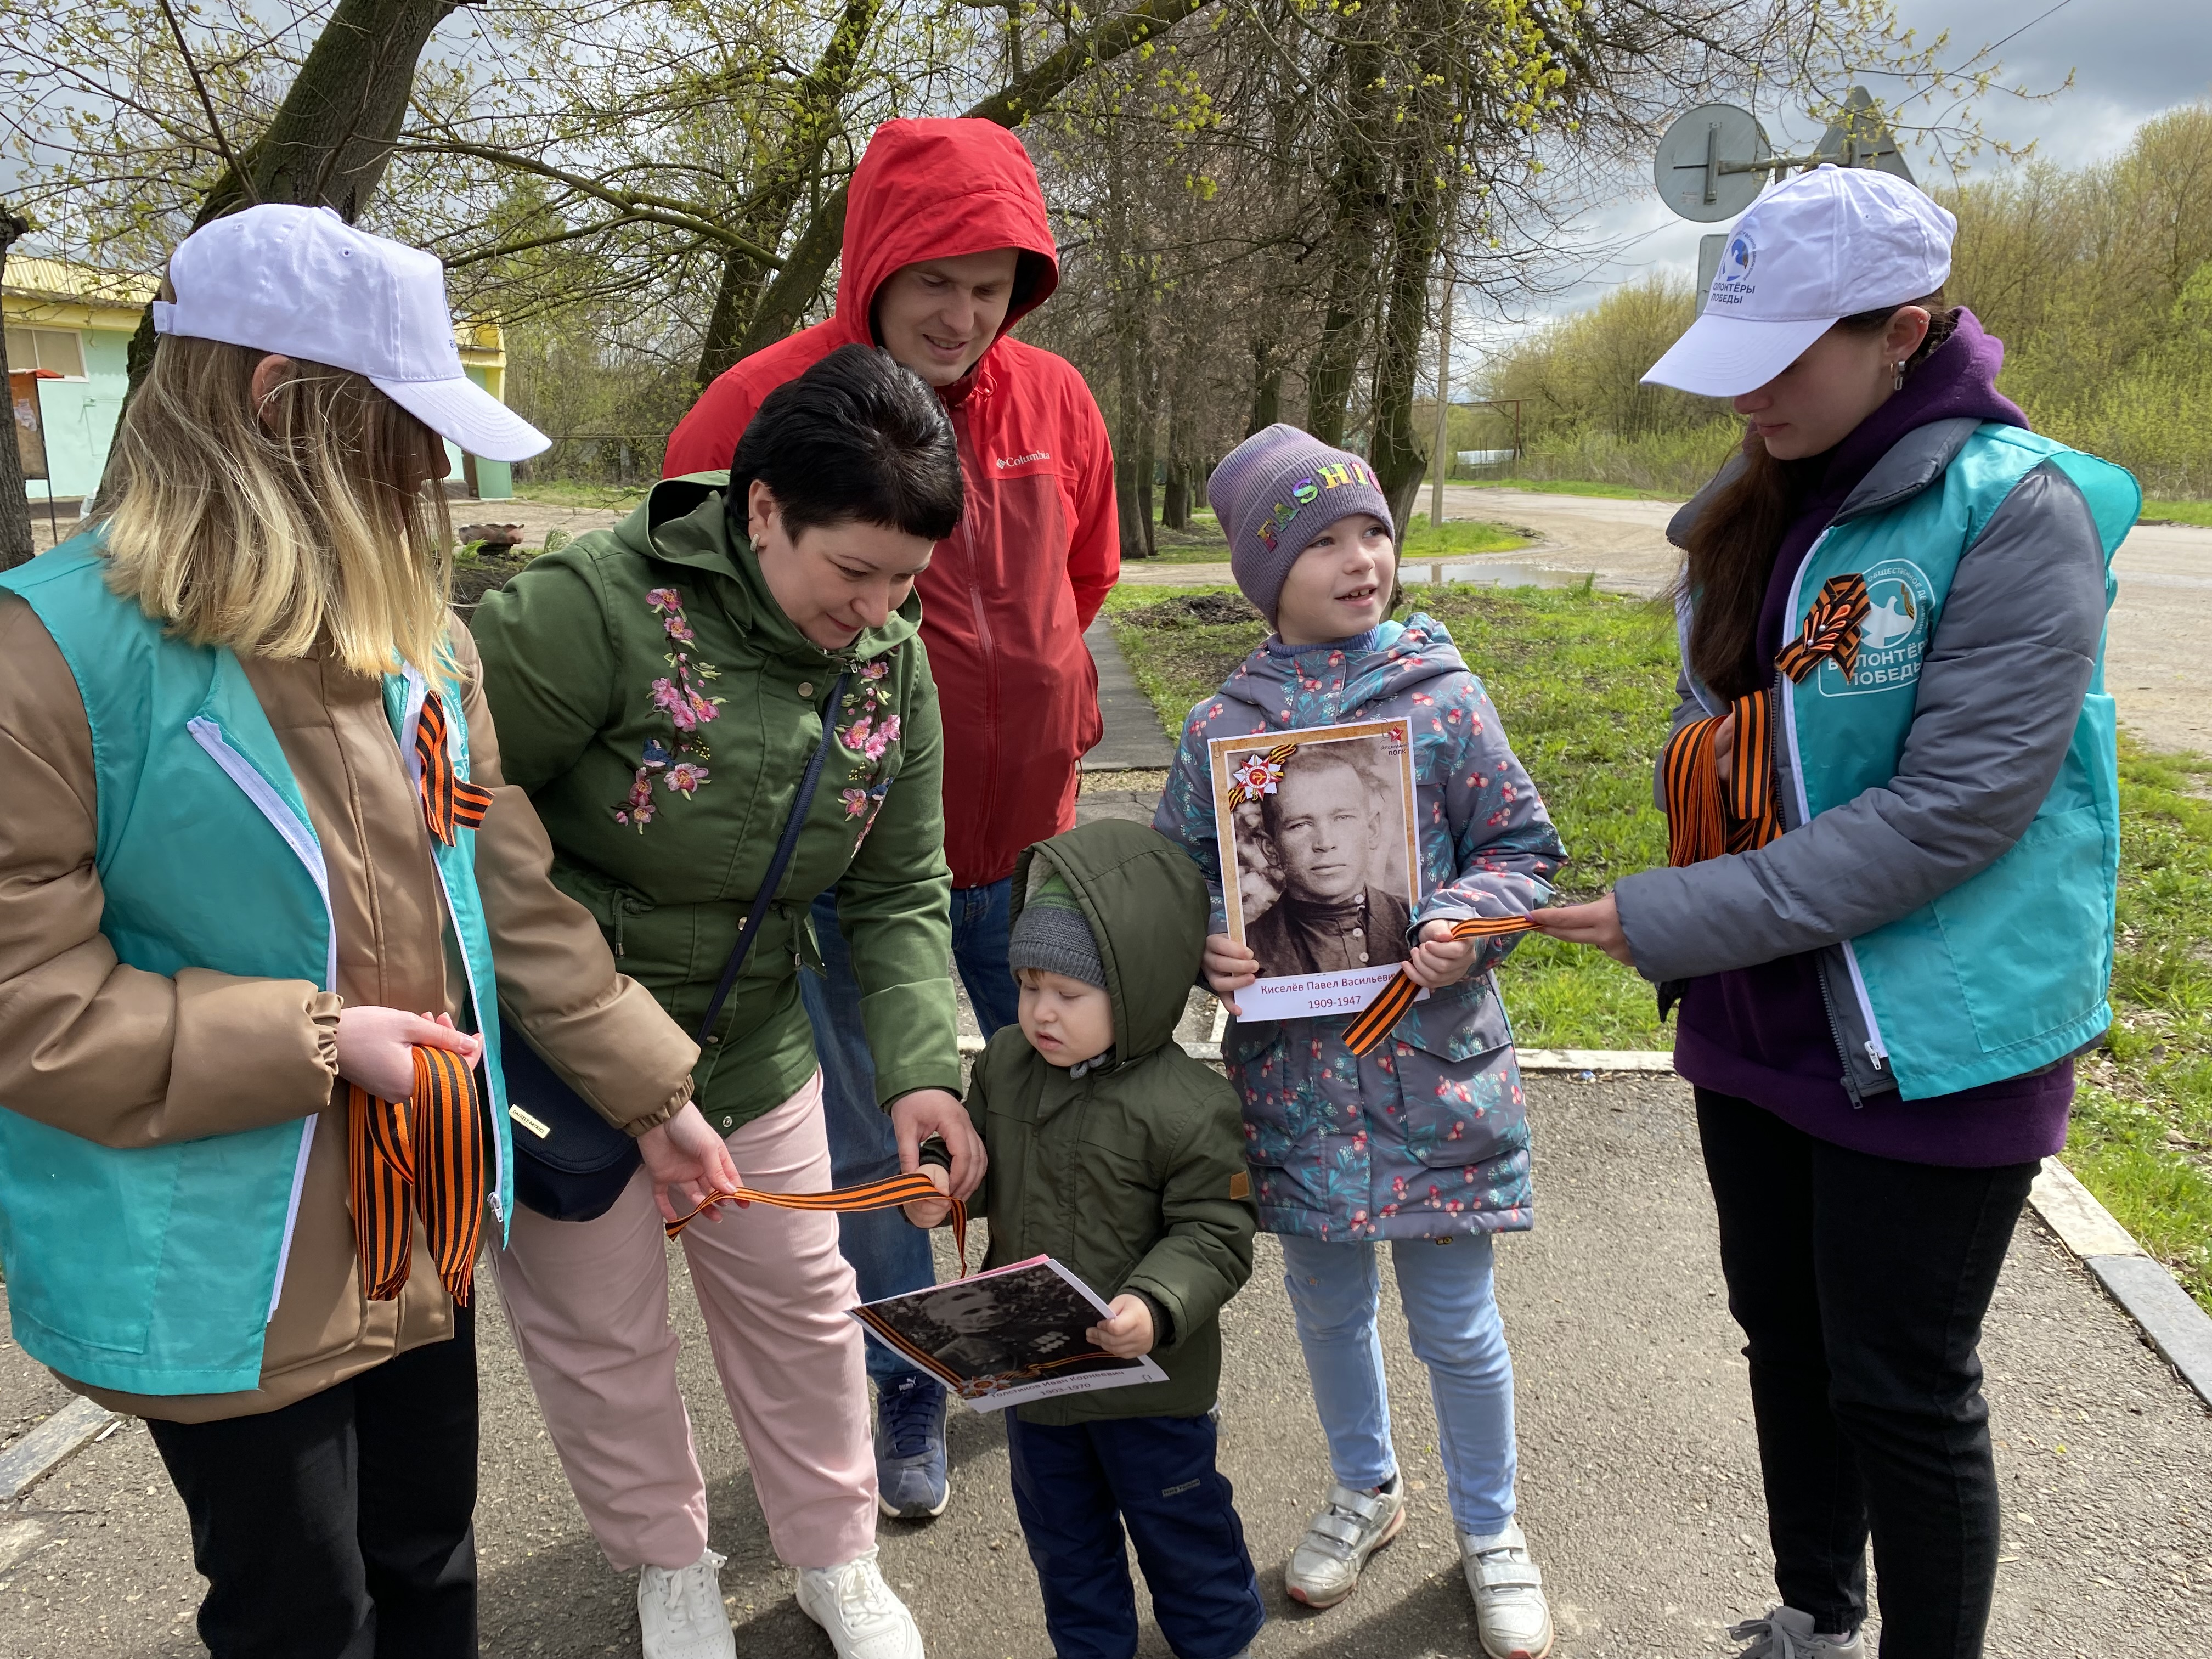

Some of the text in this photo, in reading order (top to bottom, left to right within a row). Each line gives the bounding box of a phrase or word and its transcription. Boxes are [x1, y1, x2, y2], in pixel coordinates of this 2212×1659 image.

[1713, 282, 1756, 294] ОЛОНТЁРЫ
[1711, 293, 1743, 305] ПОБЕДЫ
[1006, 450, 1051, 467] Columbia
[1867, 567, 1922, 590] ОБЩЕСТВЕННОЕ
[1828, 640, 1926, 671] ВЛОНТЁР
[453, 698, 466, 743] ДВИЖЕНИ
[1261, 983, 1304, 994] Киселёв
[1307, 979, 1339, 991] Павел
[1308, 995, 1361, 1009] 1909-1947
[513, 1109, 545, 1133] DANIELE PATRICI
[989, 1370, 1125, 1398] Толстиков Иван Корнеевич
[1040, 1383, 1091, 1396] 1903-1970
